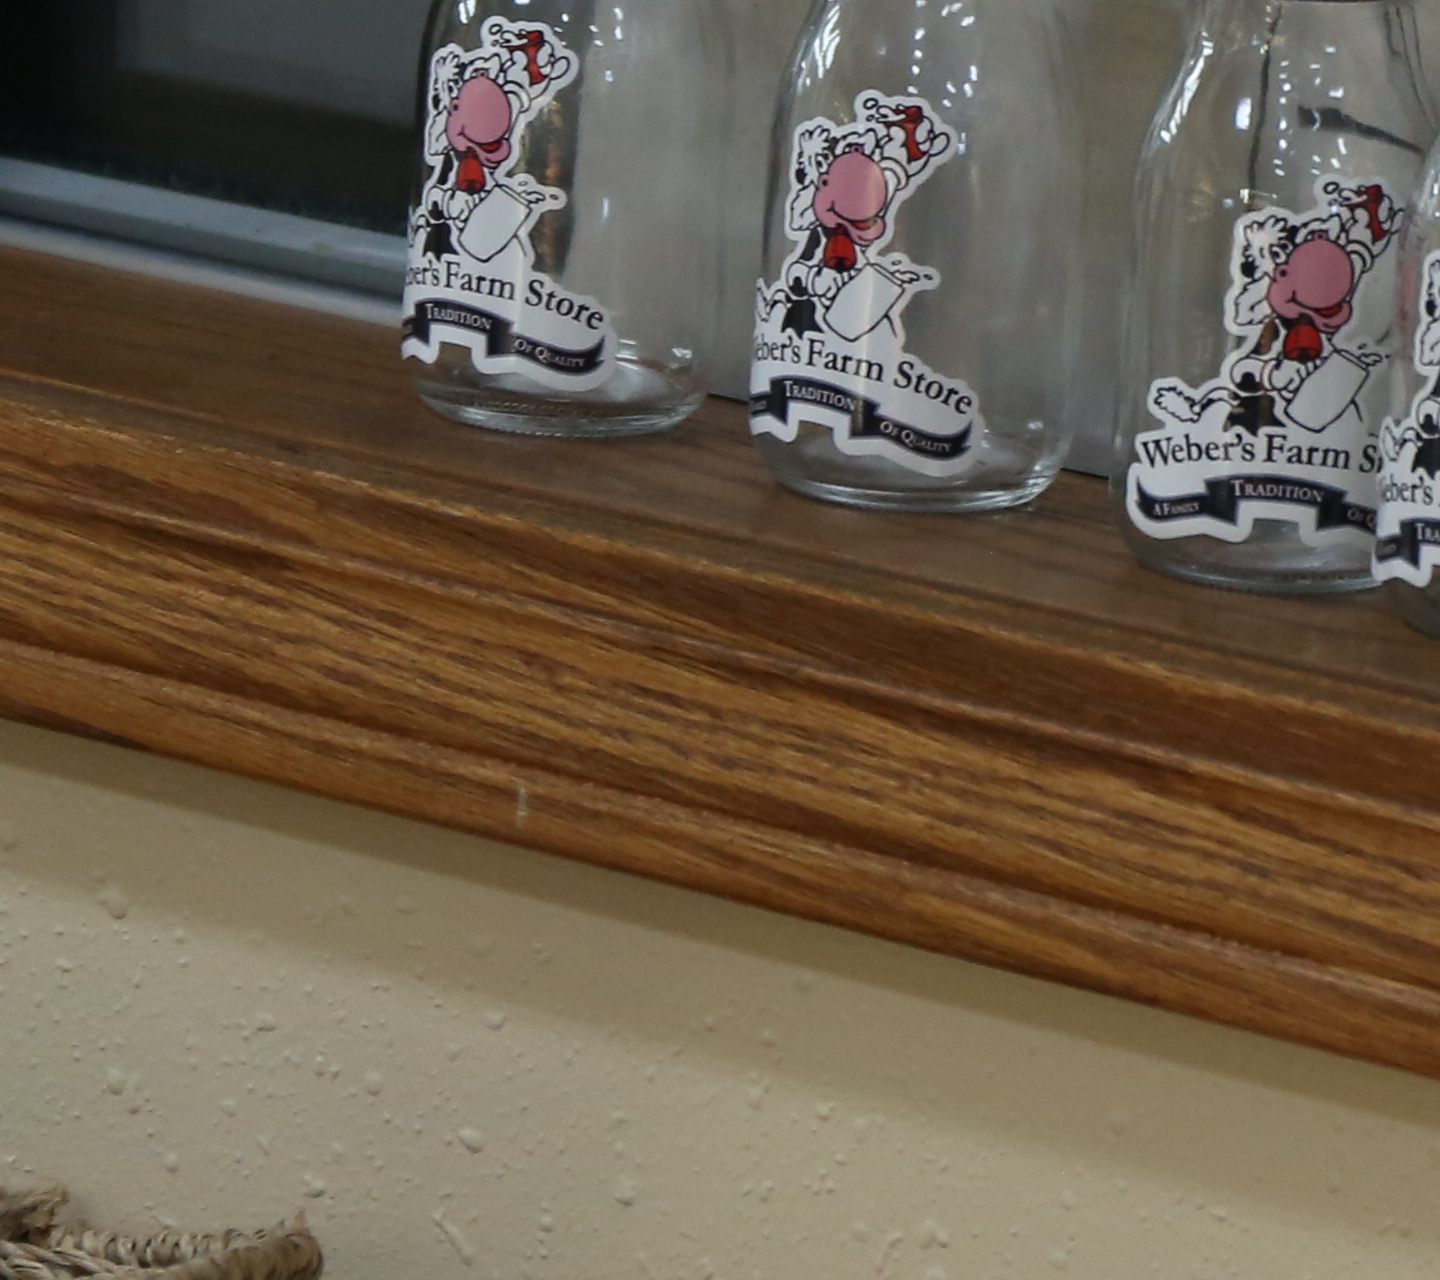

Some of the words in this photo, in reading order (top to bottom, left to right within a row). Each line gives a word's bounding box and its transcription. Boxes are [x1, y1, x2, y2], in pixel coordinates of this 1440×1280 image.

[443, 260, 516, 301] Farm
[524, 279, 604, 330] Store
[805, 337, 883, 382] Farm
[893, 360, 973, 415] Store
[1141, 432, 1256, 469] Weber's
[1262, 433, 1350, 470] Farm
